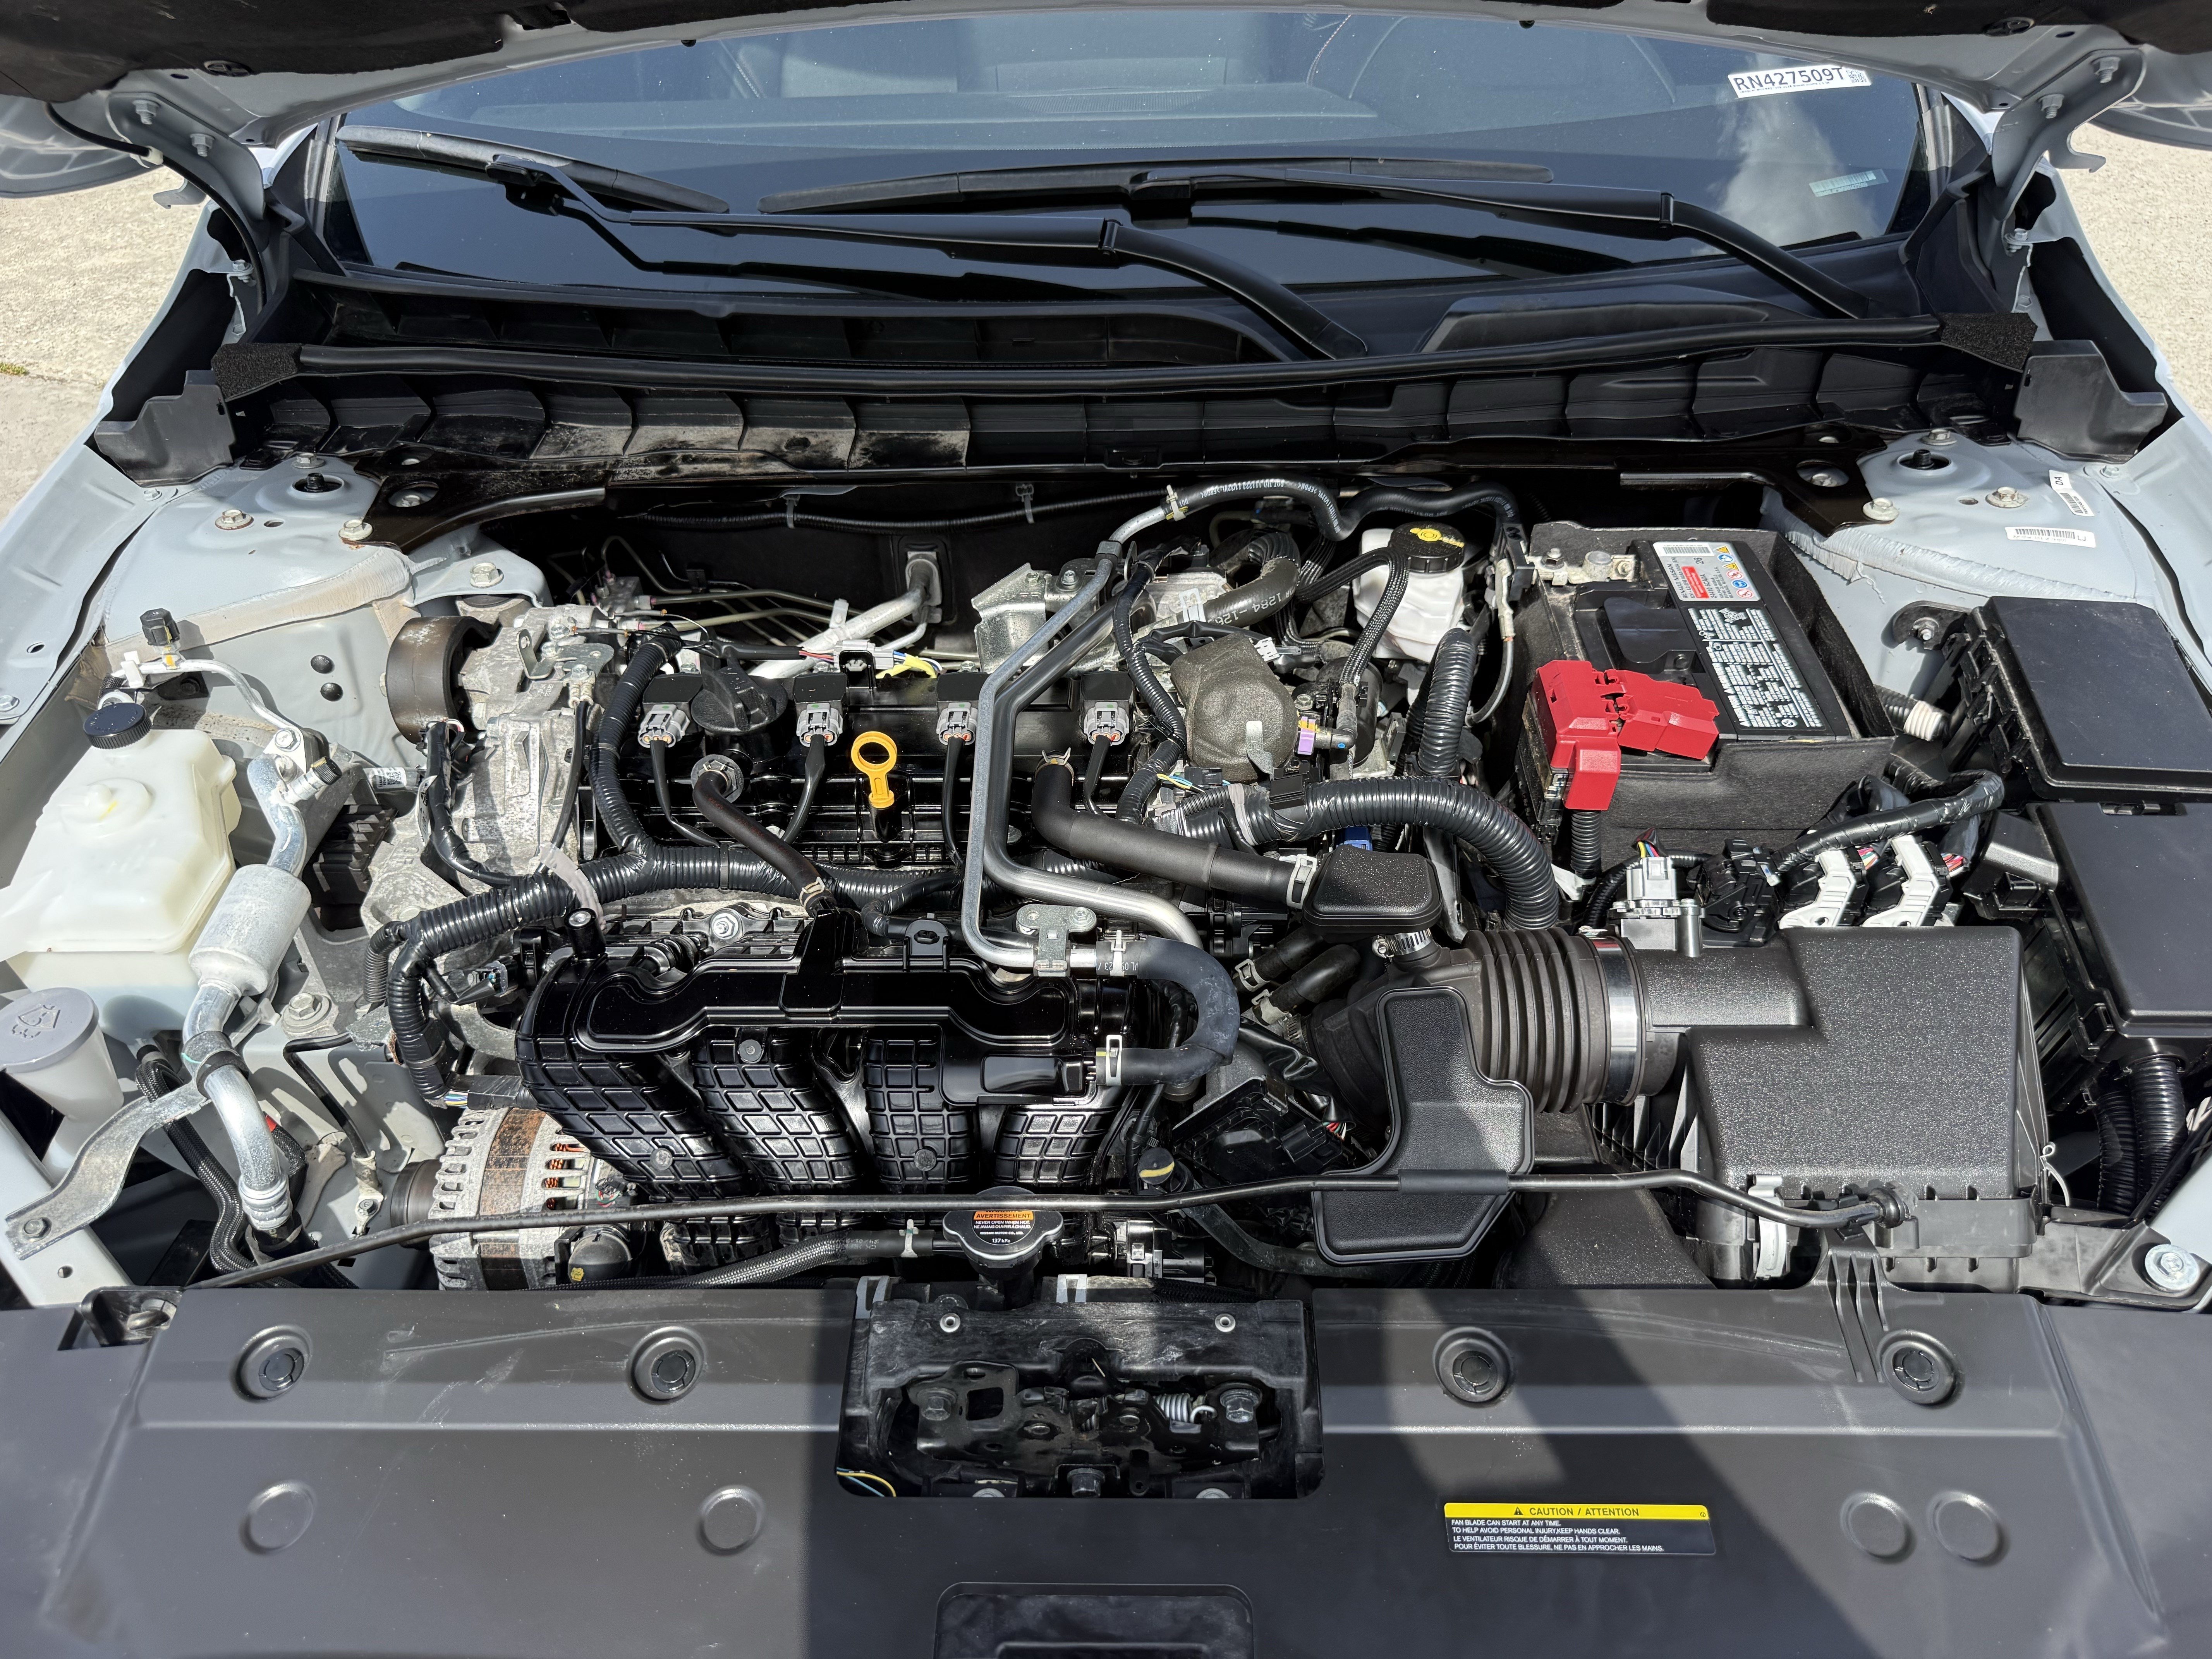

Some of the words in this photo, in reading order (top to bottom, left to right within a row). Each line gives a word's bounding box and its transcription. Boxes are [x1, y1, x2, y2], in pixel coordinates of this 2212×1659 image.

[1733, 67, 1844, 90] RN427509T
[2054, 476, 2064, 485] DA
[1666, 564, 1679, 580] NISSAN
[1252, 592, 1282, 613] 1284
[1530, 1508, 1573, 1516] CAUTION
[1577, 1508, 1582, 1516] /
[1585, 1508, 1639, 1516] ATTENTION
[1539, 1534, 1574, 1542] DÉMARRER
